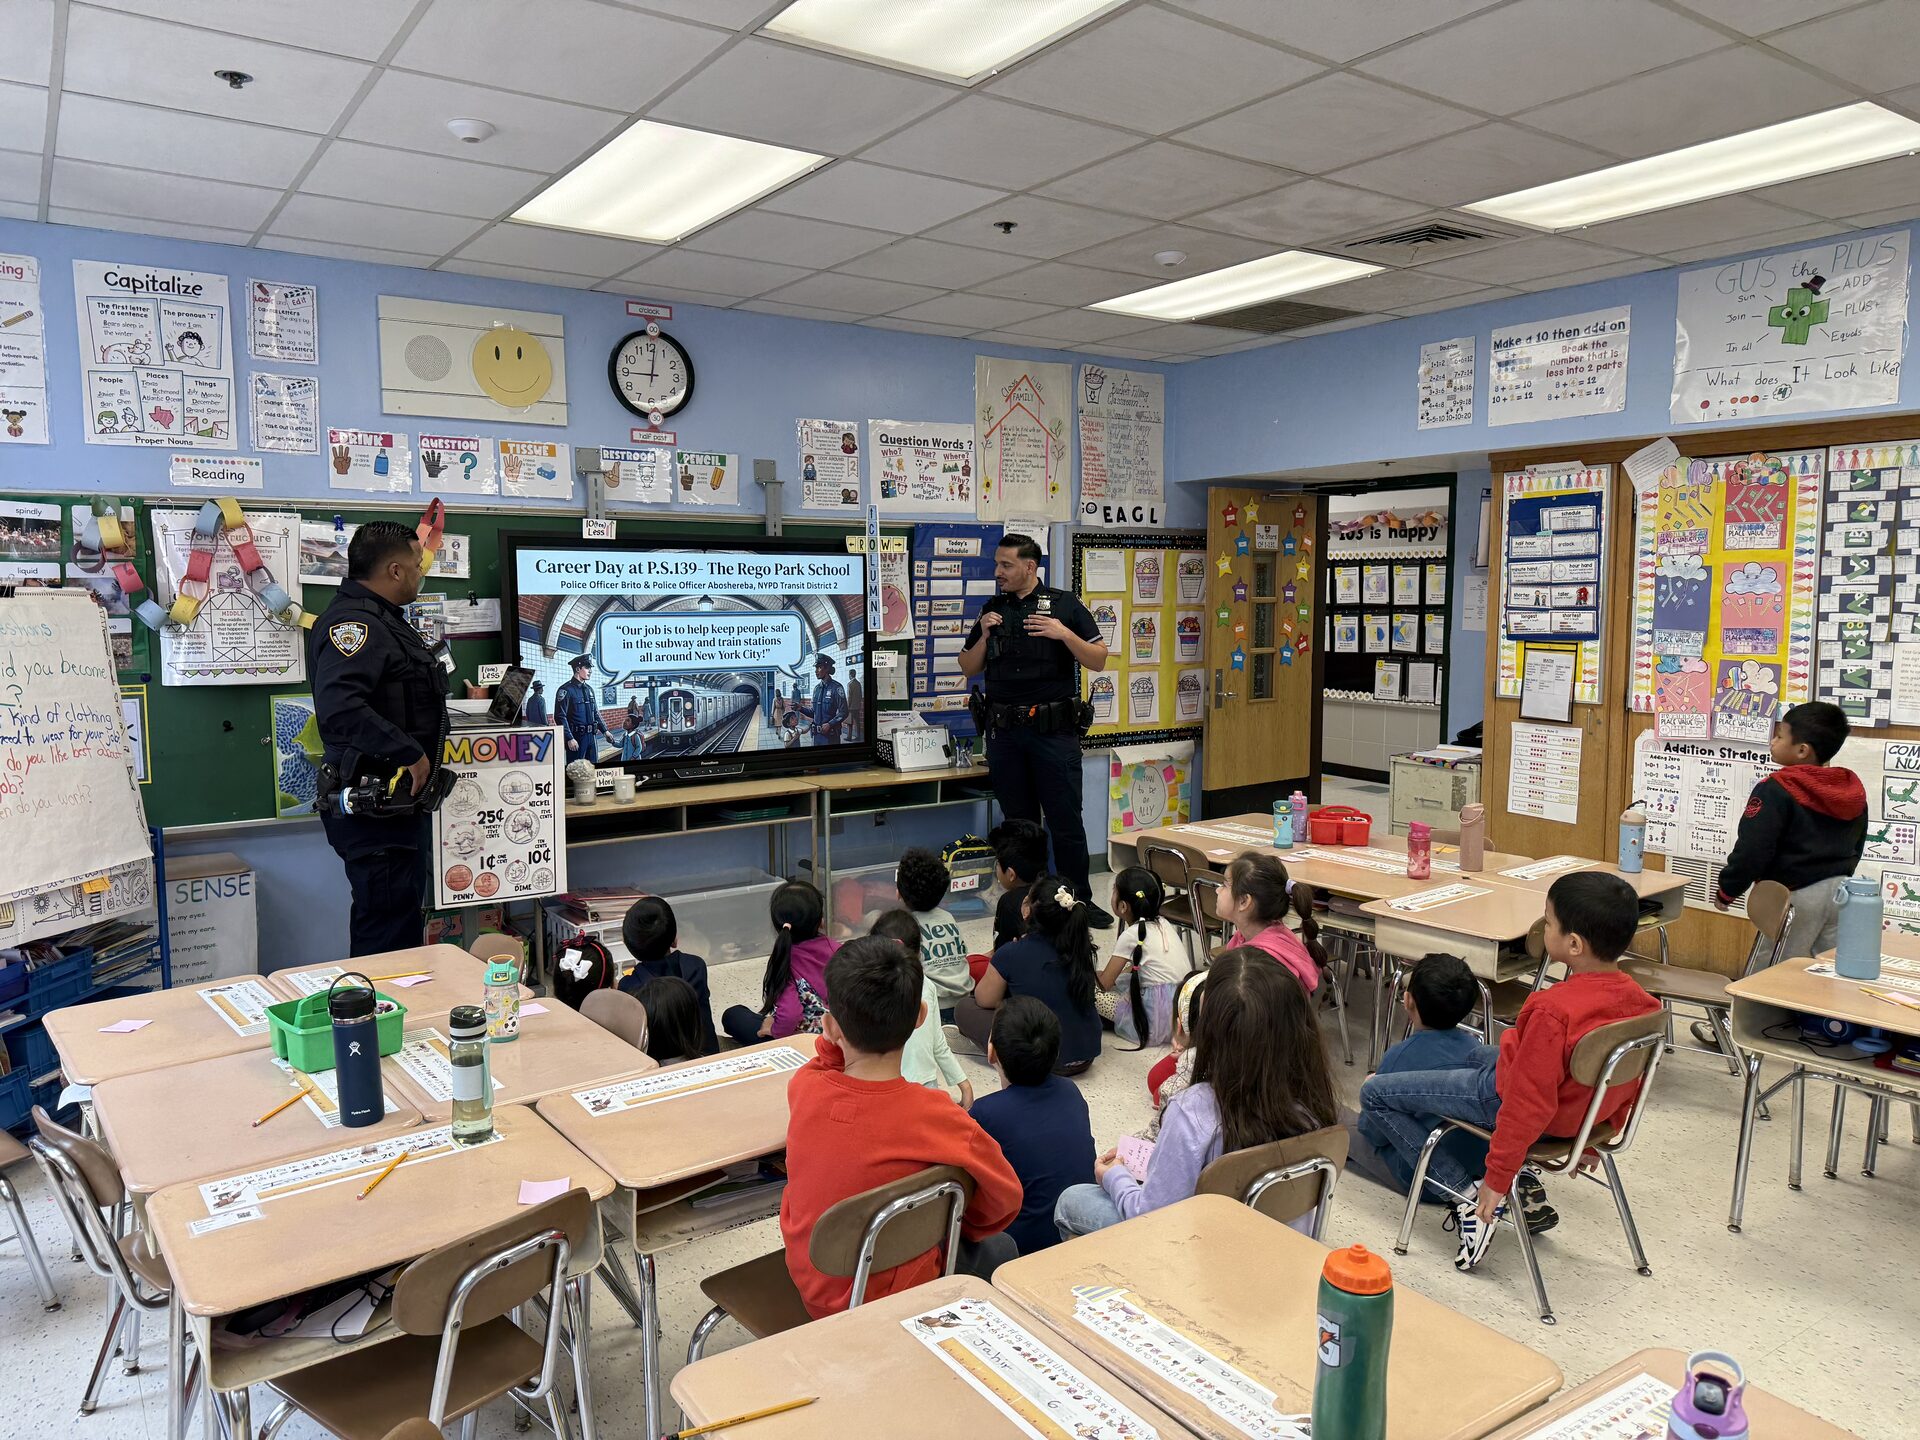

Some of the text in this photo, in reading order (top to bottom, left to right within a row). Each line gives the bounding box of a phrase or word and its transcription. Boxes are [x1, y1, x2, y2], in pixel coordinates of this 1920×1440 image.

[1715, 236, 1897, 294] GUS the PLUS
[104, 271, 203, 296] Capitalize
[1842, 273, 1871, 290] ADD
[97, 302, 150, 313] The first letter
[638, 307, 660, 316] o'clock
[1493, 320, 1626, 350] Make a 10 then add on
[1830, 328, 1862, 343] Equals
[1561, 339, 1608, 354] Break the
[624, 354, 636, 365] 10
[669, 360, 676, 370] 2
[1550, 349, 1619, 367] number that is
[146, 372, 169, 381] Places
[622, 367, 630, 377] 9
[1546, 361, 1623, 378] less into 2 parts
[1706, 370, 1741, 386] What
[1754, 371, 1779, 386] does
[1792, 365, 1810, 384] It
[1824, 362, 1858, 380] Look
[98, 376, 123, 386] People
[194, 380, 217, 389] Things
[673, 373, 680, 383] 3
[1012, 392, 1034, 403] FAMILY
[135, 435, 194, 447] Proper Nouns
[339, 432, 384, 447] DRINK
[421, 437, 479, 451] QUESTION
[879, 433, 973, 450] Question Words ?
[508, 442, 549, 457] TISSUE
[602, 450, 656, 463] RESTROOM
[881, 447, 902, 457] Who?
[914, 449, 936, 458] What?
[943, 452, 970, 460] Where?
[683, 454, 721, 466] PENCIL
[191, 466, 245, 484] Reading
[882, 470, 908, 482] When?
[919, 474, 935, 482] How
[951, 474, 970, 485] Why?
[15, 508, 42, 516] spindly
[588, 528, 605, 537] Less
[1370, 526, 1381, 541] is
[859, 538, 891, 551] ROW
[948, 540, 968, 548] Today's
[17, 567, 38, 577] liquid
[535, 559, 591, 575] Career
[595, 560, 624, 578] Day
[629, 562, 644, 575] at
[707, 562, 734, 576] The
[737, 562, 771, 579] Rego
[774, 563, 805, 576] Park
[808, 563, 850, 577] School
[560, 580, 838, 592] Police Officer Brito & Police Officer Aboshereba, NYPD Transit District 2
[643, 624, 661, 638] job
[663, 624, 673, 636] is
[674, 625, 685, 636] to
[687, 624, 709, 637] help
[711, 623, 735, 637] keep
[737, 623, 769, 637] people
[770, 621, 790, 634] safe
[622, 635, 782, 651] in the subway and train stations
[639, 651, 653, 663] all
[655, 650, 692, 663] around
[694, 650, 715, 662] New
[718, 649, 741, 661] York
[0, 649, 108, 685] id you become
[936, 680, 956, 689] Writing
[47, 702, 60, 723] of
[65, 704, 113, 731] clothing
[26, 727, 36, 747] to
[42, 730, 65, 745] wear
[68, 724, 82, 743] for
[84, 728, 104, 745] your
[106, 727, 121, 747] job?
[442, 732, 553, 765] MONEY
[1664, 742, 1771, 765] Addition Strategi
[6, 739, 123, 776] do you like best about
[535, 780, 553, 797] 5¢
[16, 784, 92, 818] do you work?
[477, 808, 505, 825] 25¢
[1139, 805, 1155, 818] ALLY
[1886, 812, 1916, 821] less than
[528, 847, 551, 865] 10¢
[174, 873, 251, 905] SENSE
[514, 884, 532, 892] DIME
[952, 879, 975, 890] Red
[452, 892, 475, 901] PENNY
[170, 929, 186, 937] with
[199, 926, 216, 934] ears.
[919, 923, 960, 942] New
[920, 936, 967, 962] York
[972, 1338, 1013, 1371] Jahir
